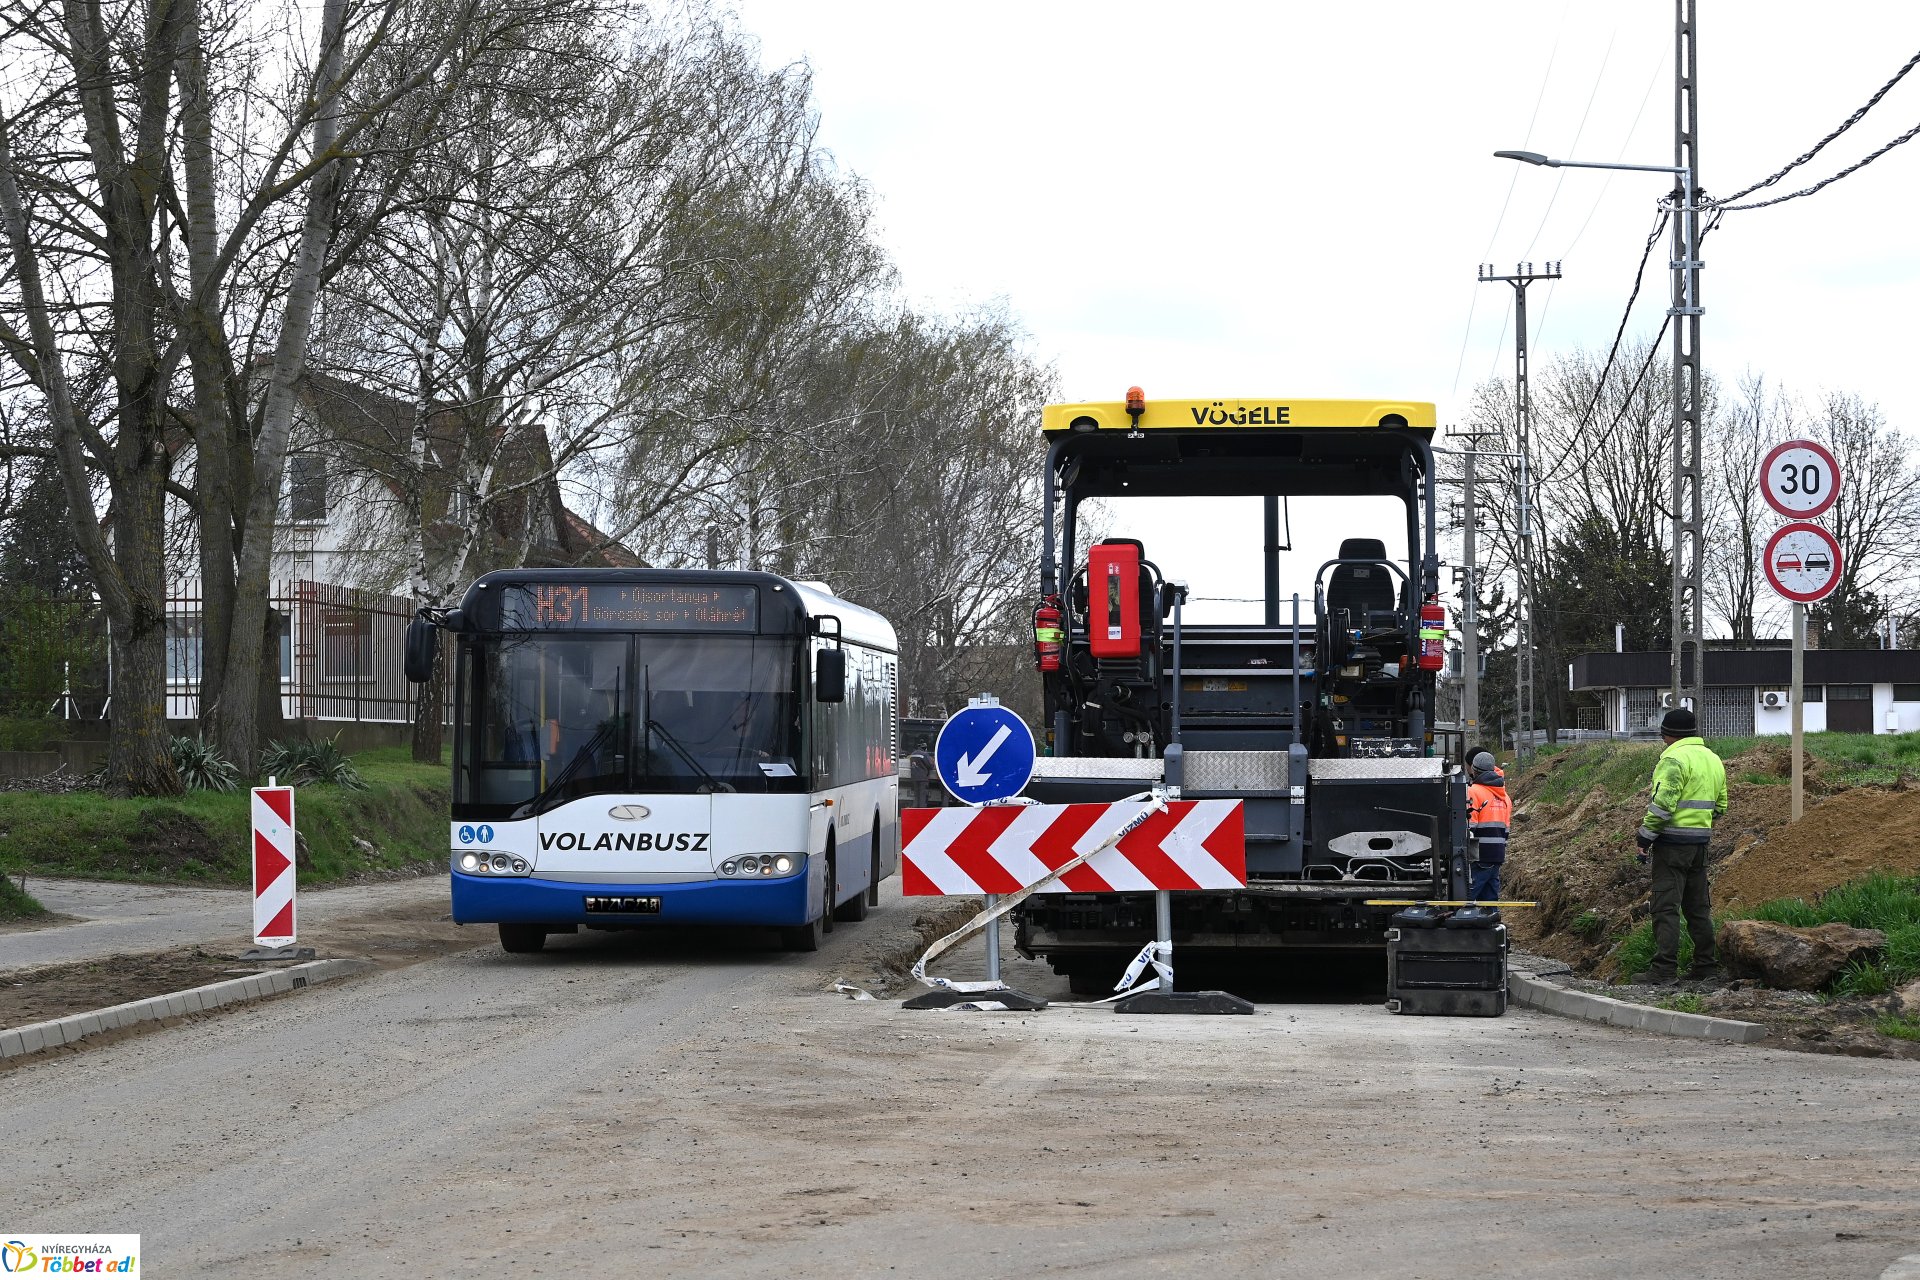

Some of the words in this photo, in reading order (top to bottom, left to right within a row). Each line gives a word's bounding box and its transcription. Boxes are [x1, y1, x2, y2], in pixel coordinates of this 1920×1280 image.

[1191, 402, 1290, 425] VÖGELE
[1780, 464, 1820, 495] 30
[537, 586, 588, 622] H31
[539, 832, 710, 851] VOLÁNBUSZ
